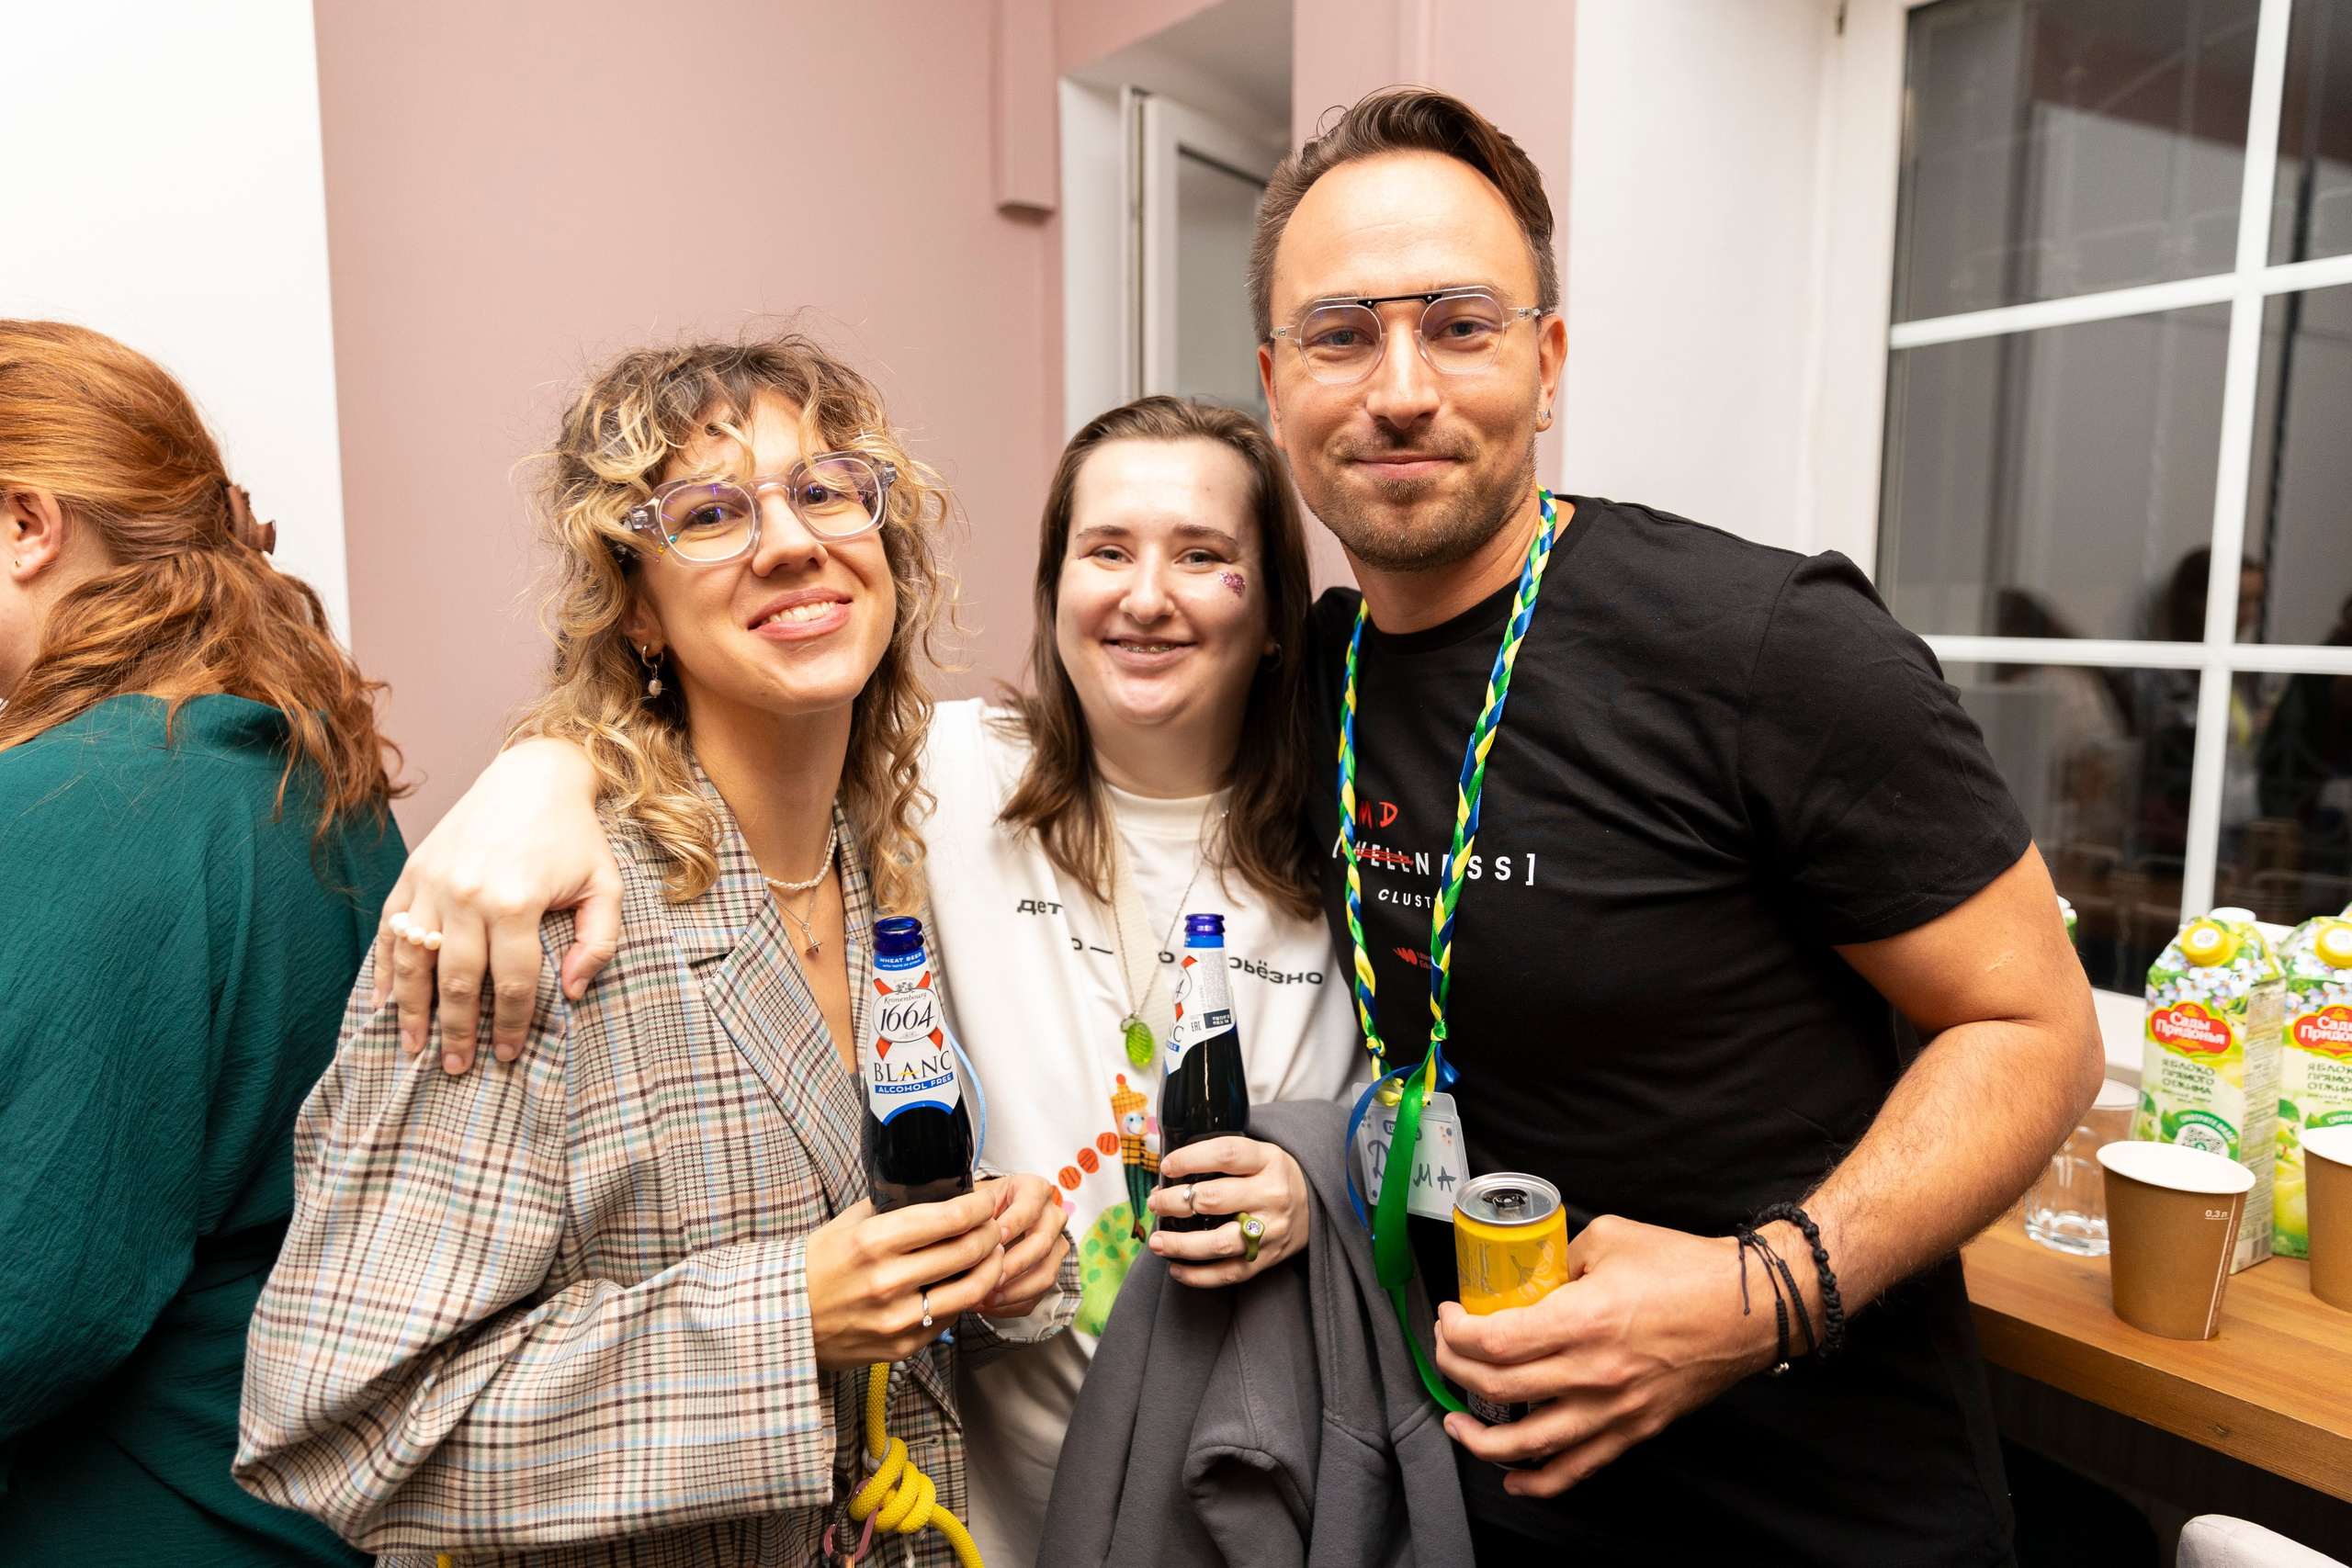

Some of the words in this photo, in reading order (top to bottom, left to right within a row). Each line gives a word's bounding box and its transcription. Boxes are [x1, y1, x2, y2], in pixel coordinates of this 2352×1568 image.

[1016, 899, 1063, 916] дет
[1378, 888, 1437, 909] CLUST
[884, 992, 927, 1006] Kronenbourg
[880, 999, 936, 1032] 1664
[2169, 1011, 2211, 1032] Сады
[2155, 1018, 2226, 1046] Придонья
[2300, 1024, 2352, 1043] Придо
[874, 1050, 953, 1082] BLANC
[2161, 1058, 2216, 1076] ЯБЛОКО
[2307, 1063, 2352, 1075] ЯБЛОК
[878, 1083, 928, 1093] ALCOHOL
[931, 1073, 952, 1087] FREE
[2307, 1073, 2352, 1085] ПРЯМО
[2307, 1082, 2352, 1093] ОТЖИМ
